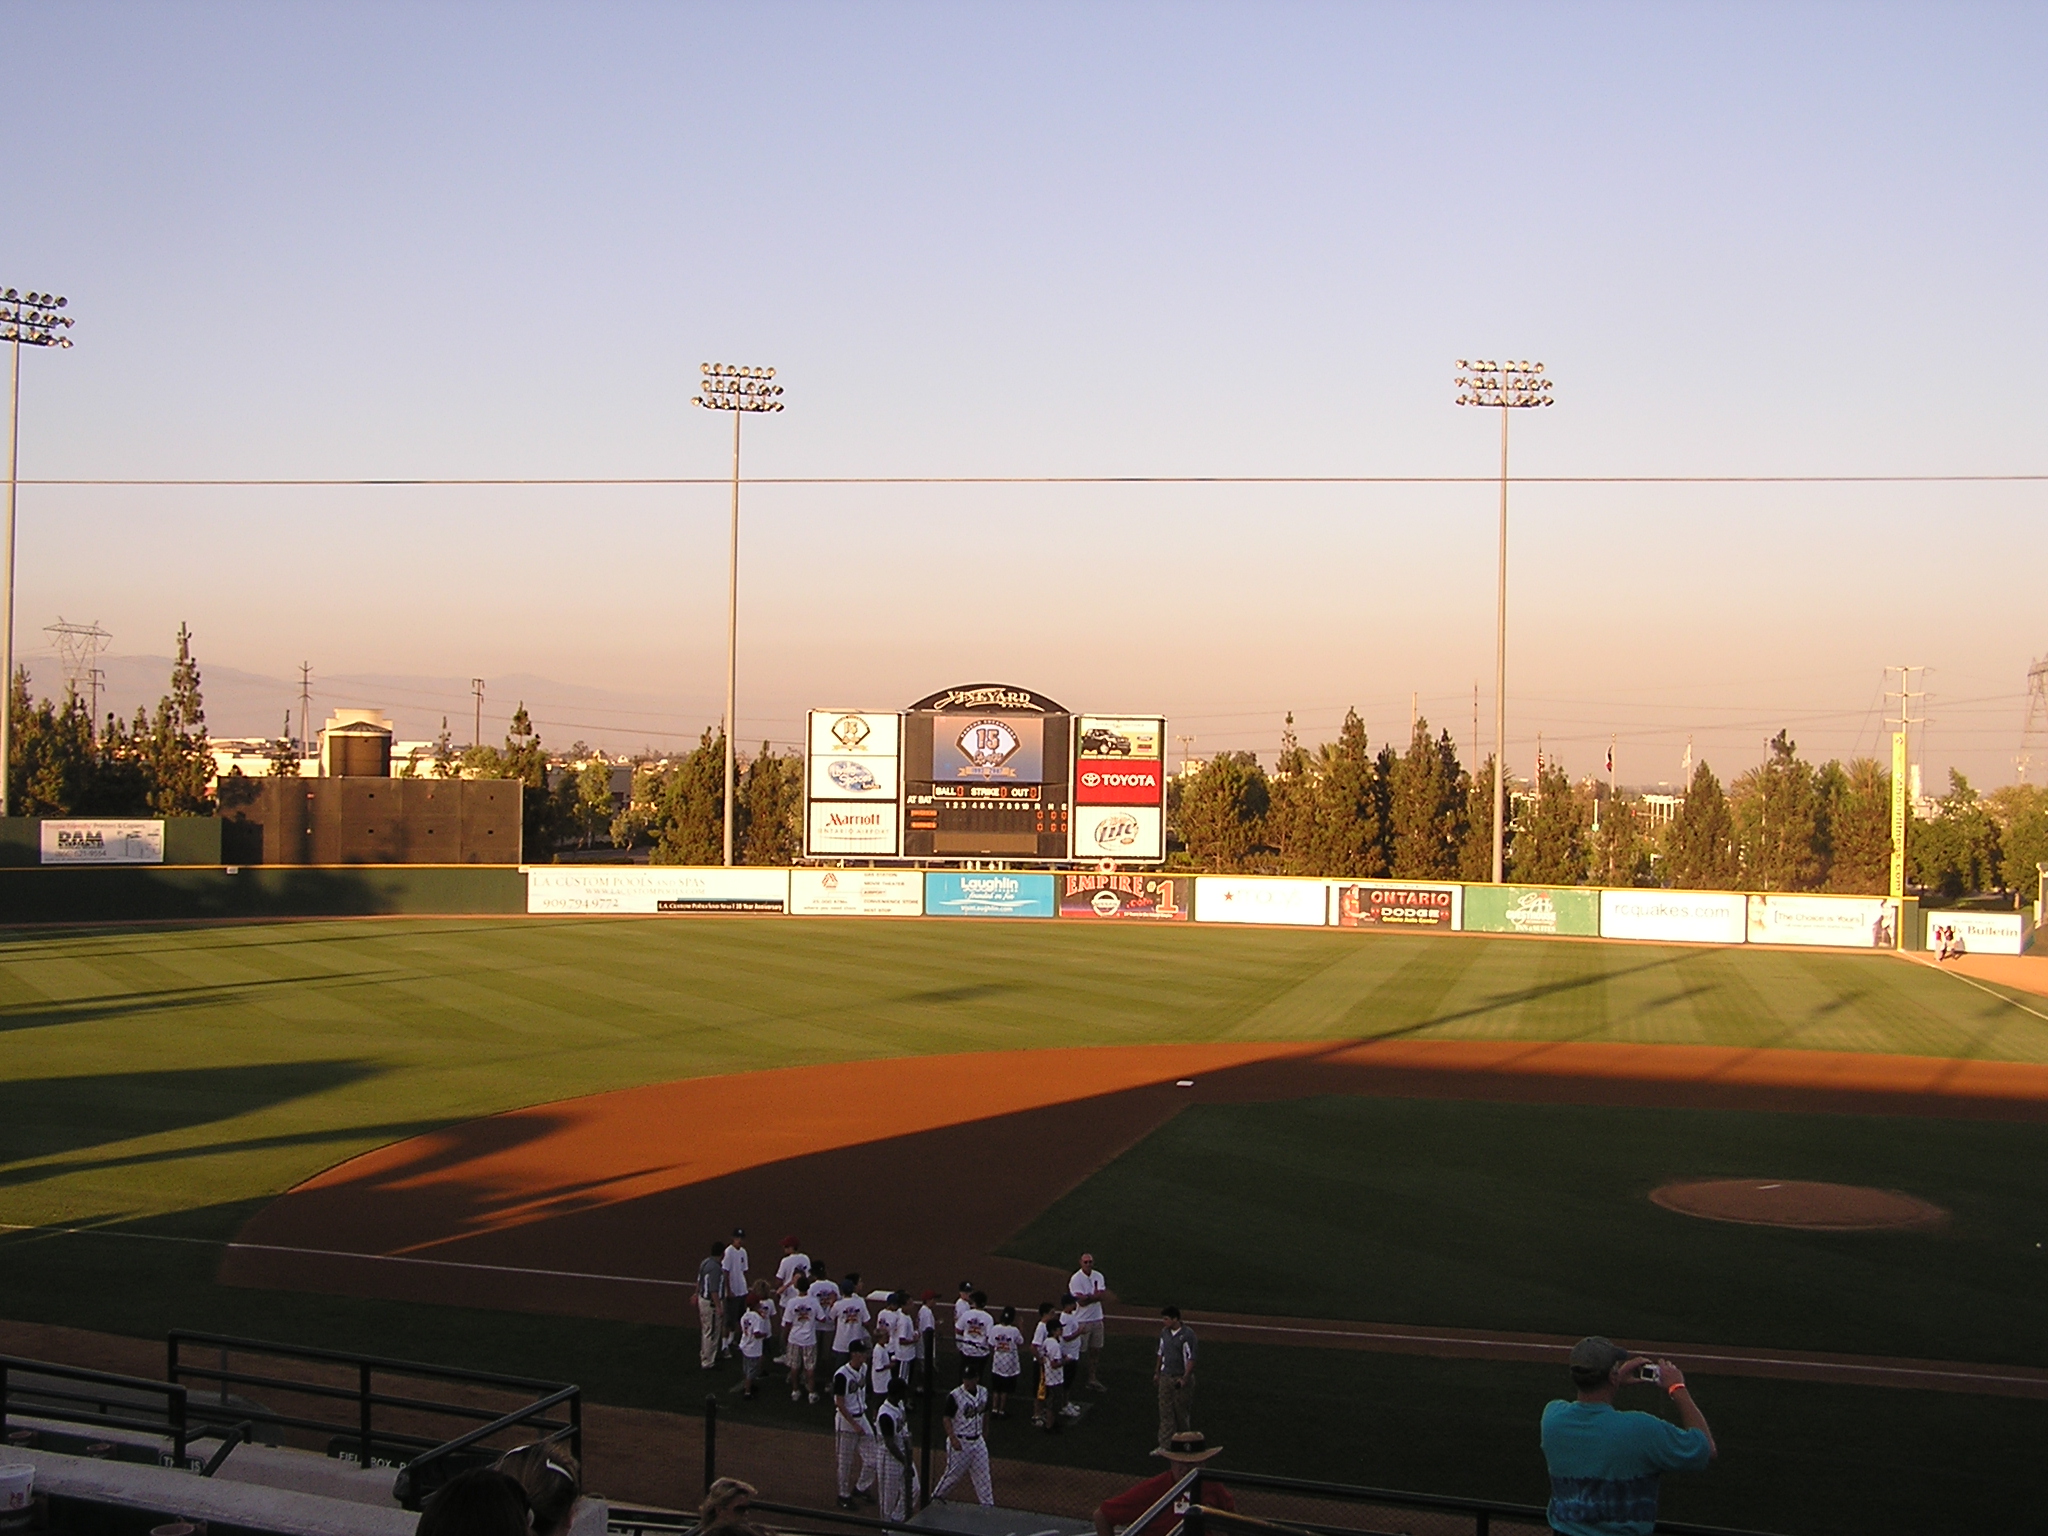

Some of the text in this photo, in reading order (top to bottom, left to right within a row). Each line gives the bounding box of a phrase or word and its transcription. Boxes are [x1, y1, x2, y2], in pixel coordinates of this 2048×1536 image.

[947, 691, 1031, 703] VINEYARD
[976, 728, 1000, 750] 15
[1101, 774, 1156, 787] TOYOTA
[936, 787, 956, 796] BALL
[971, 788, 999, 796] STRIKE
[1011, 788, 1029, 797] OUT
[907, 796, 932, 804] AT BAT
[945, 802, 950, 810] 1
[953, 802, 958, 810] 2
[961, 802, 966, 810] 3
[972, 802, 977, 810] 4
[980, 802, 985, 810] 5
[988, 802, 993, 810] 6
[999, 802, 1004, 810] 7
[1007, 802, 1012, 810] 8
[1022, 802, 1030, 810] 10
[1035, 802, 1041, 810] R
[826, 813, 880, 826] Marriott
[556, 877, 609, 887] CUSTOM
[613, 877, 652, 887] POOLS
[679, 878, 705, 887] SPAS
[960, 877, 1019, 893] Laughlin
[1066, 875, 1145, 897] EMPIRE
[1370, 891, 1450, 906] ONTARIO
[1381, 907, 1440, 918] DODGE
[1614, 903, 1730, 918] rcquakes.com
[1795, 913, 1825, 921] Choice
[1967, 925, 2019, 937] Bulletin
